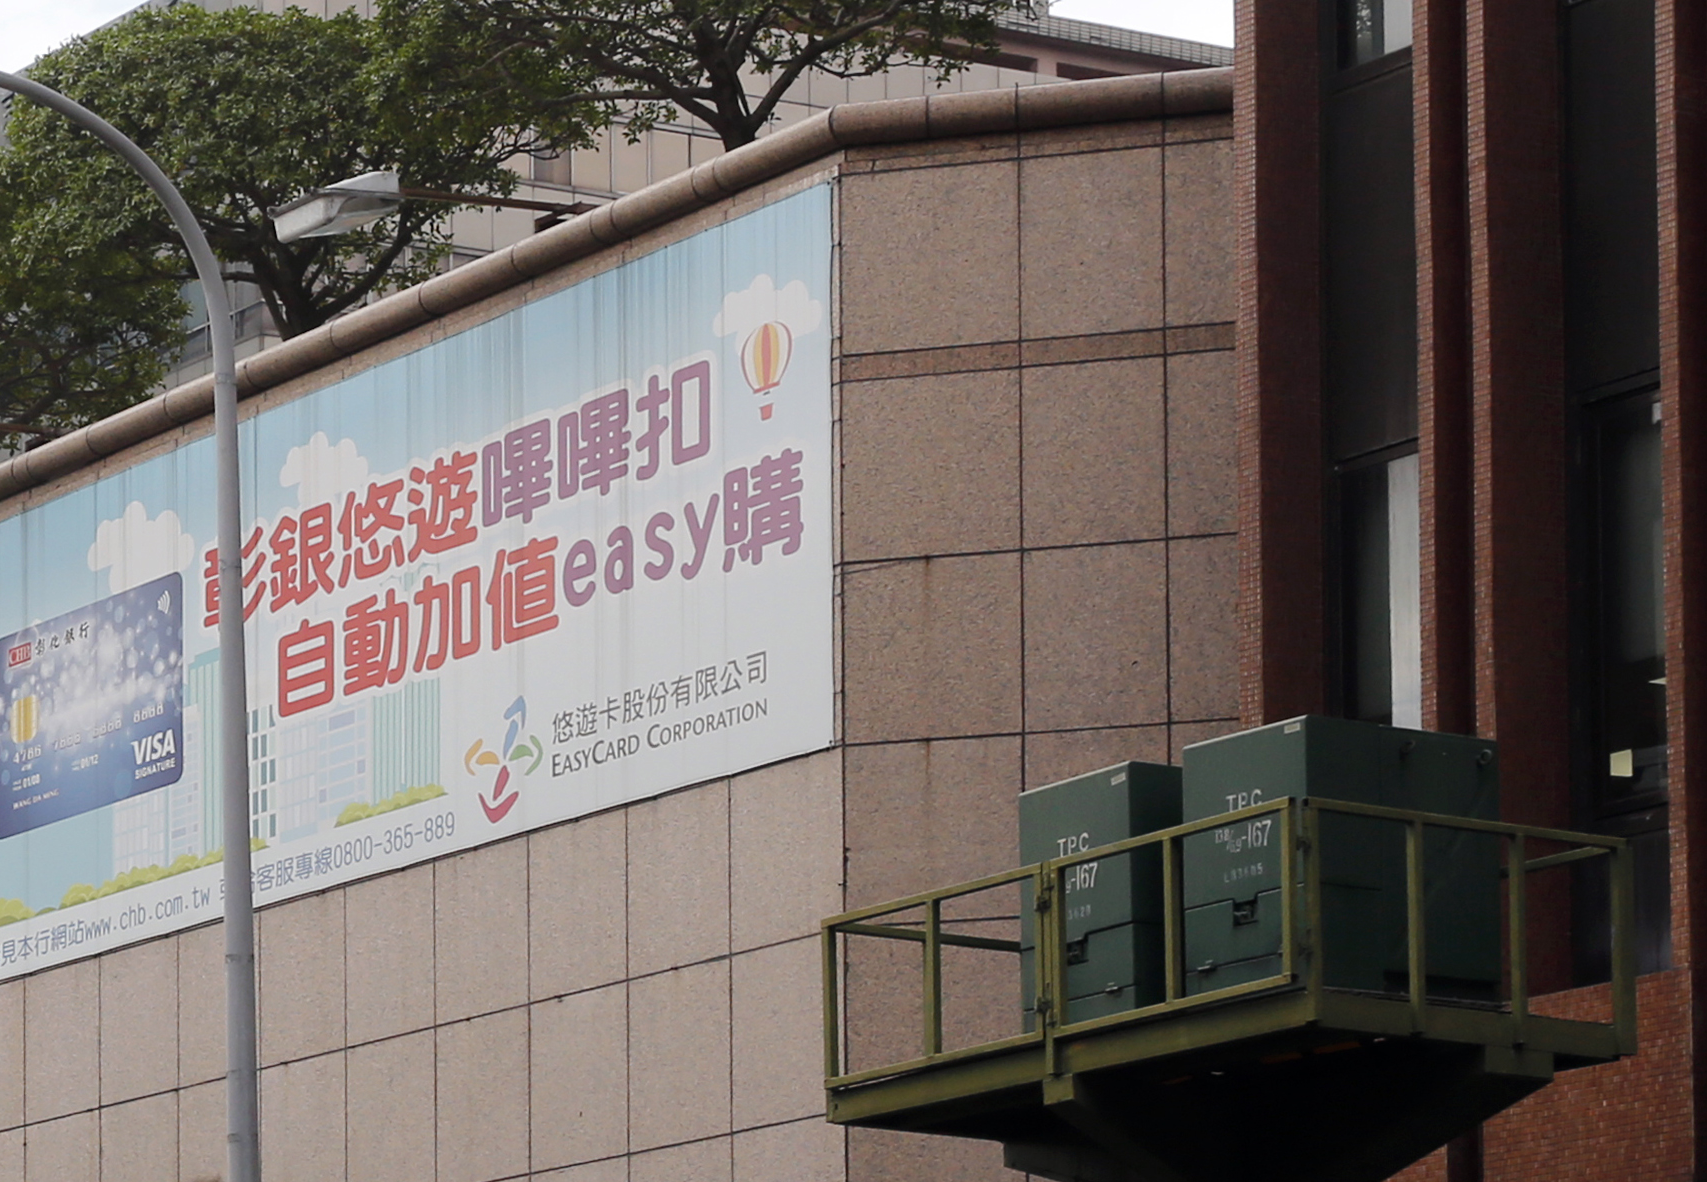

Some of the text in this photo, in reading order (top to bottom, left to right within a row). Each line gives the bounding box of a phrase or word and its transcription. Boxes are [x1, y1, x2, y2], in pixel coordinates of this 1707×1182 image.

[277, 447, 804, 718] 自動加值easy購
[553, 650, 767, 745] 悠遊卡股份有限公司
[131, 729, 176, 766] VISA
[134, 757, 176, 780] SIGNATURE
[1226, 789, 1263, 813] TPC
[220, 812, 455, 901] 客服專線0800-365-889
[1057, 832, 1090, 858] TPC
